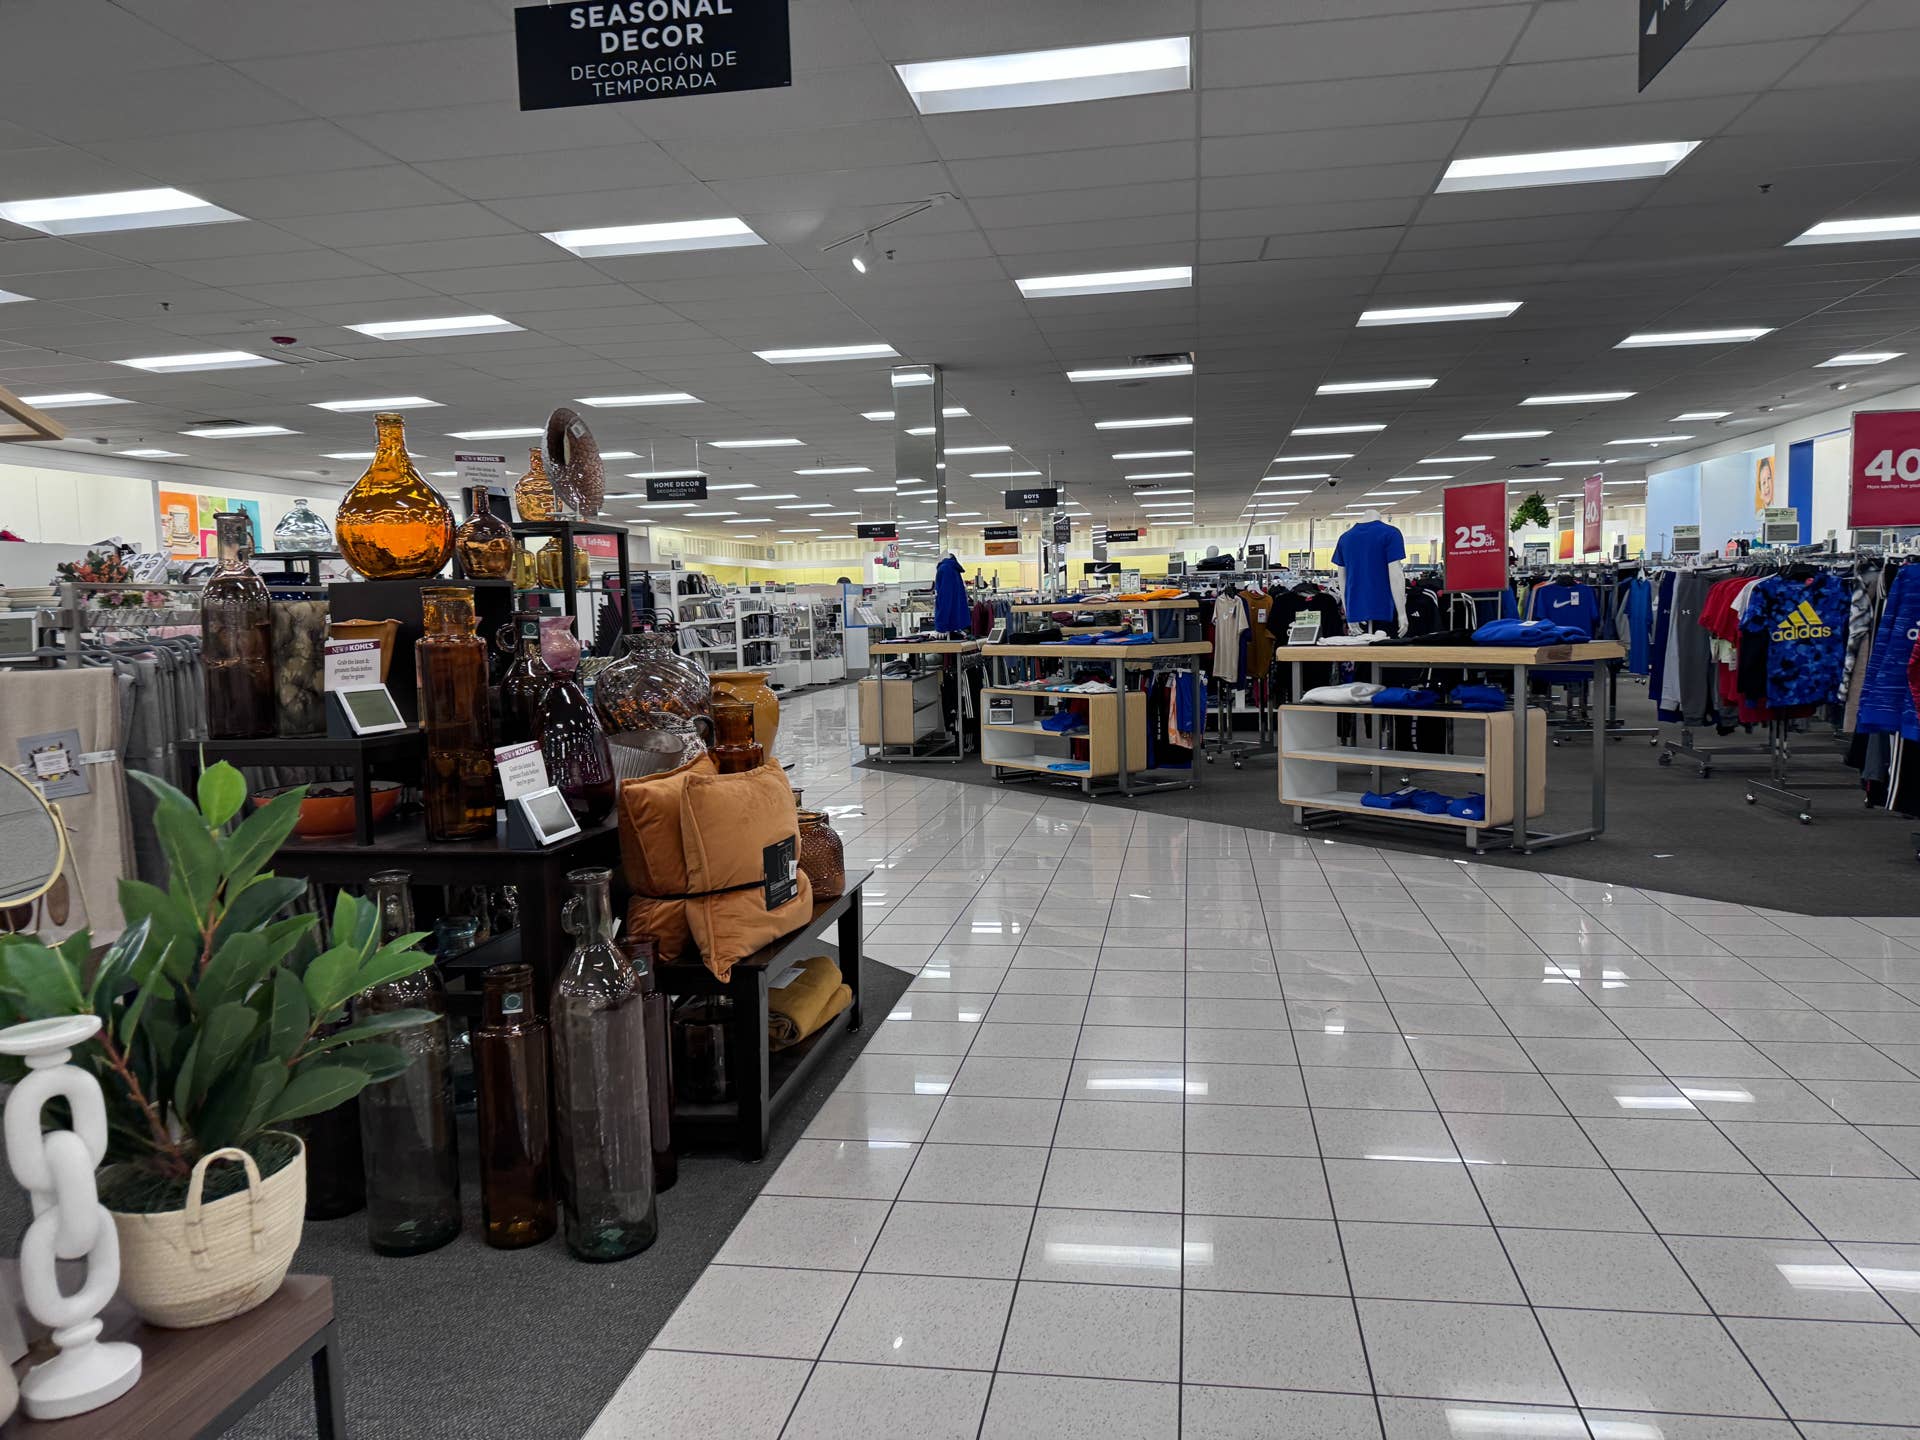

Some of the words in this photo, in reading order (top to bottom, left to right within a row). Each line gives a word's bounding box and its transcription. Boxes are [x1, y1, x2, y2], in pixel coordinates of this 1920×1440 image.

[570, 0, 733, 29] SEASONAL
[601, 24, 704, 53] DECOR
[571, 53, 703, 80] DECORACIÓN
[711, 51, 737, 67] DE
[592, 73, 717, 97] TEMPORADA
[1771, 624, 1831, 641] adidas
